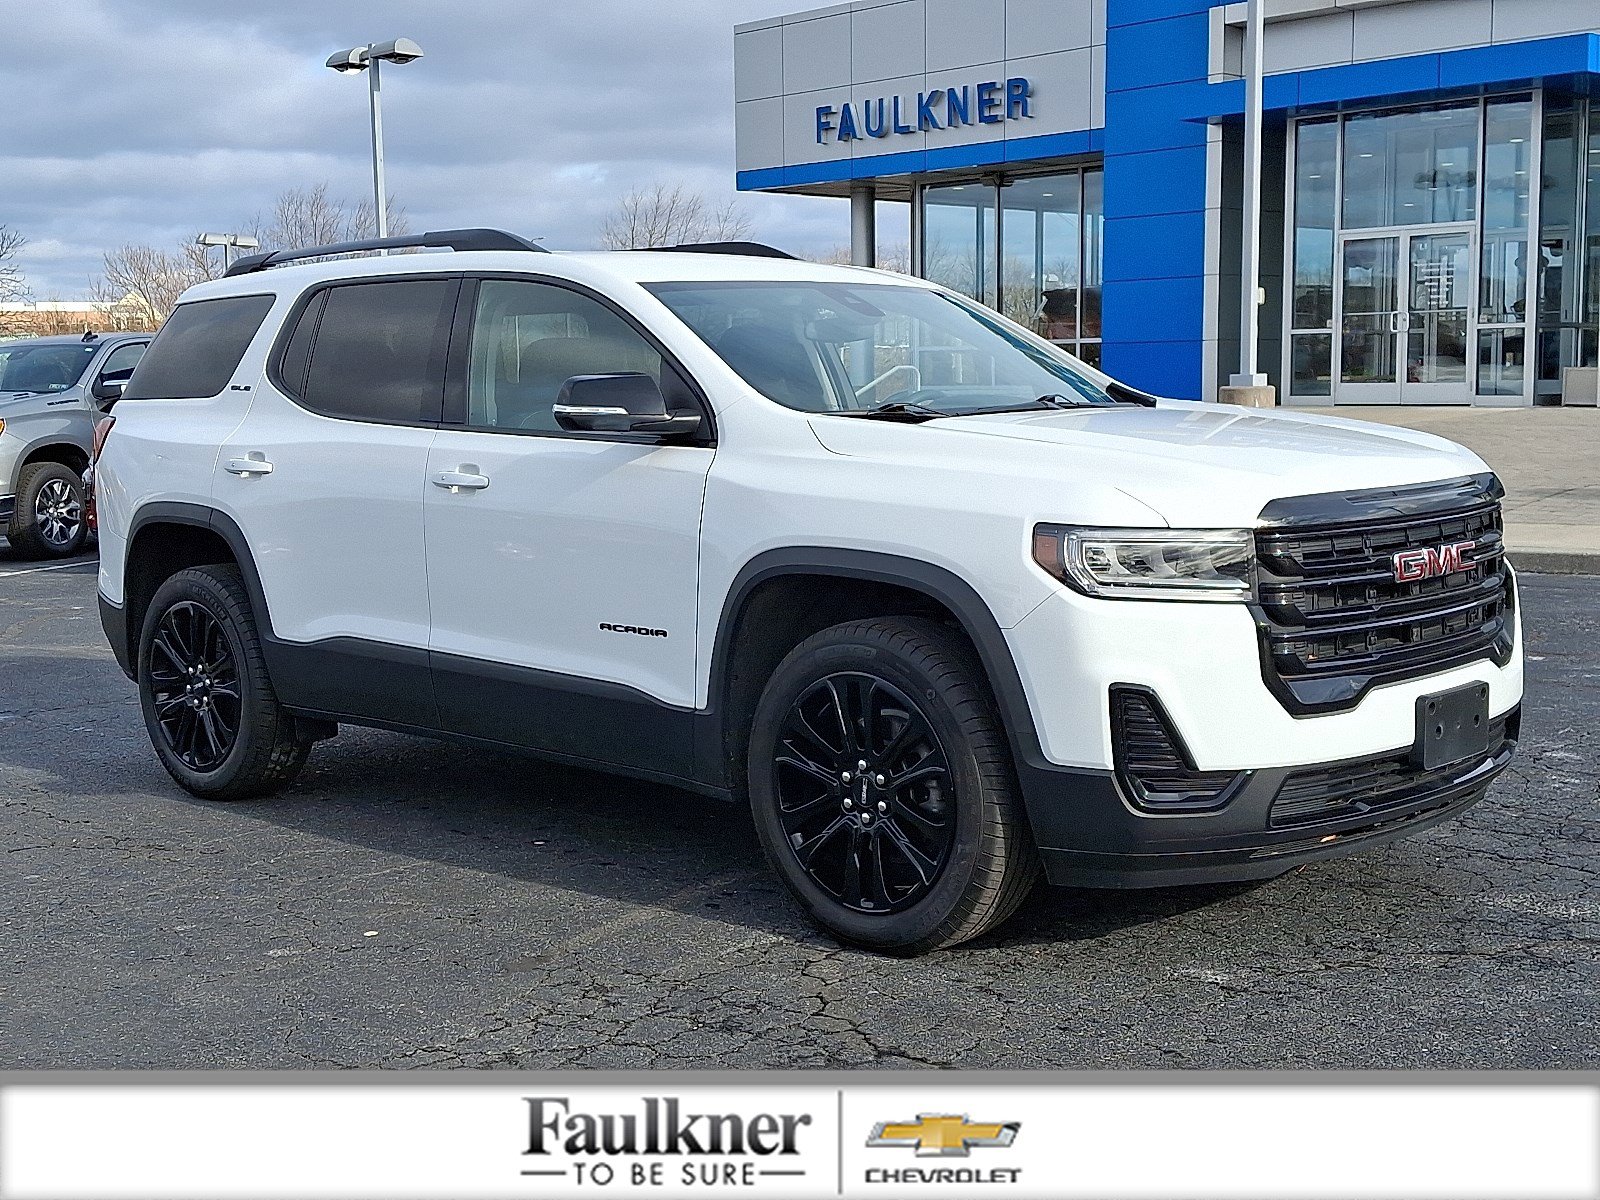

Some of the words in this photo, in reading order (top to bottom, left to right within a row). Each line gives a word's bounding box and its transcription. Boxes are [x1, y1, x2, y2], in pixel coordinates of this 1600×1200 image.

[816, 77, 1034, 144] FAULKNER
[1394, 541, 1476, 583] GMC
[599, 622, 668, 638] ACADIA
